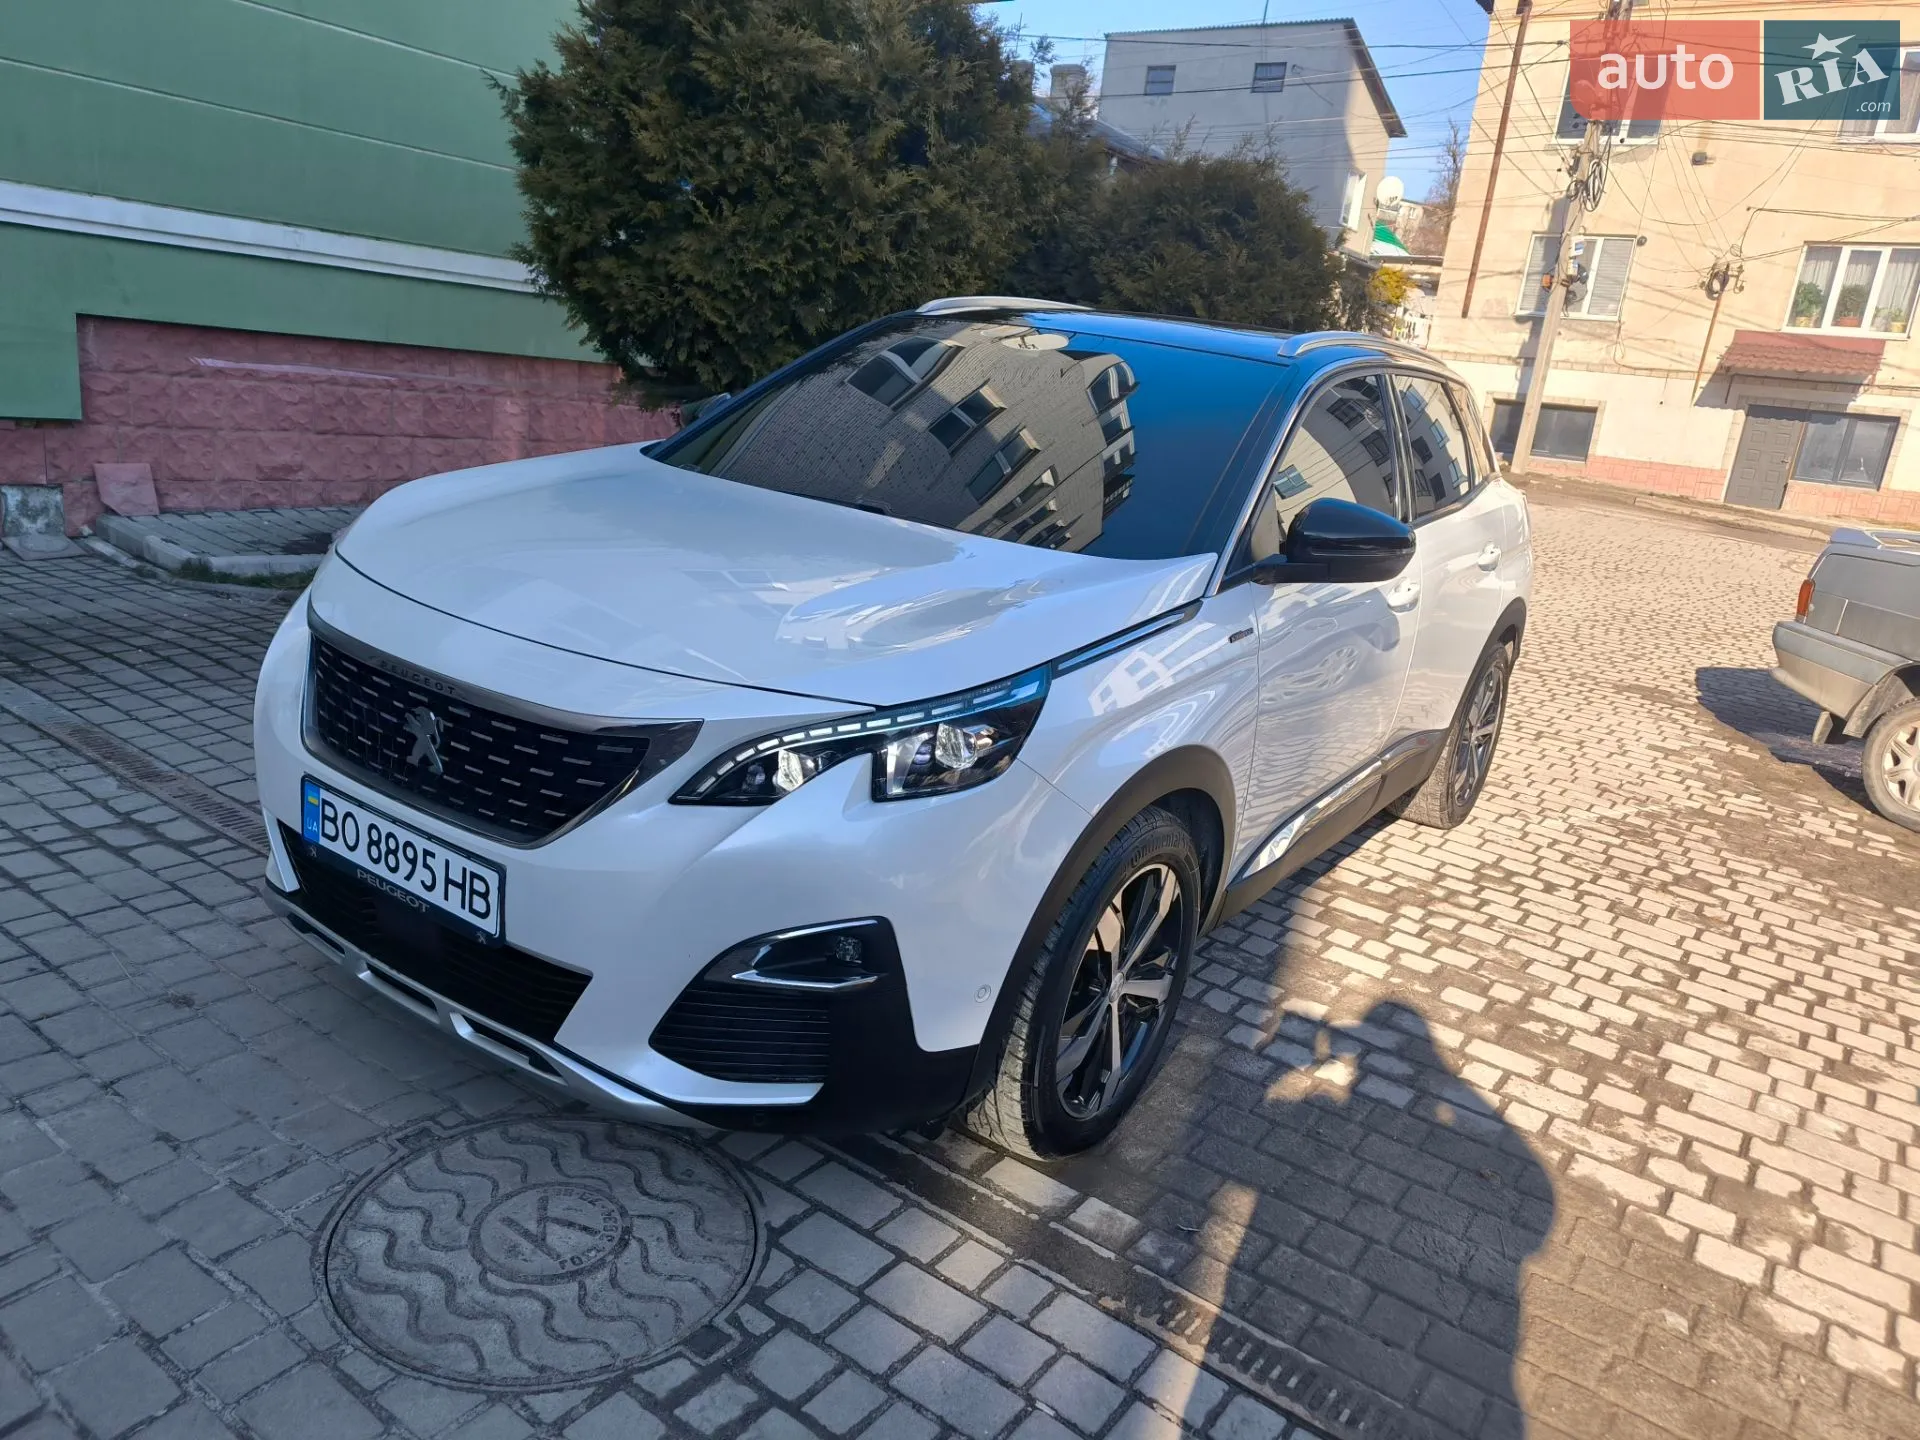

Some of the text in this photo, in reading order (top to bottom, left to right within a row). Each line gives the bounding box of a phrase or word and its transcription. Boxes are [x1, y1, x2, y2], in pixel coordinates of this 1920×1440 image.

[380, 660, 456, 696] PEUGEOT
[306, 816, 319, 833] UA
[320, 797, 492, 920] BO 8895 HB
[356, 868, 430, 913] PEUGEOT
